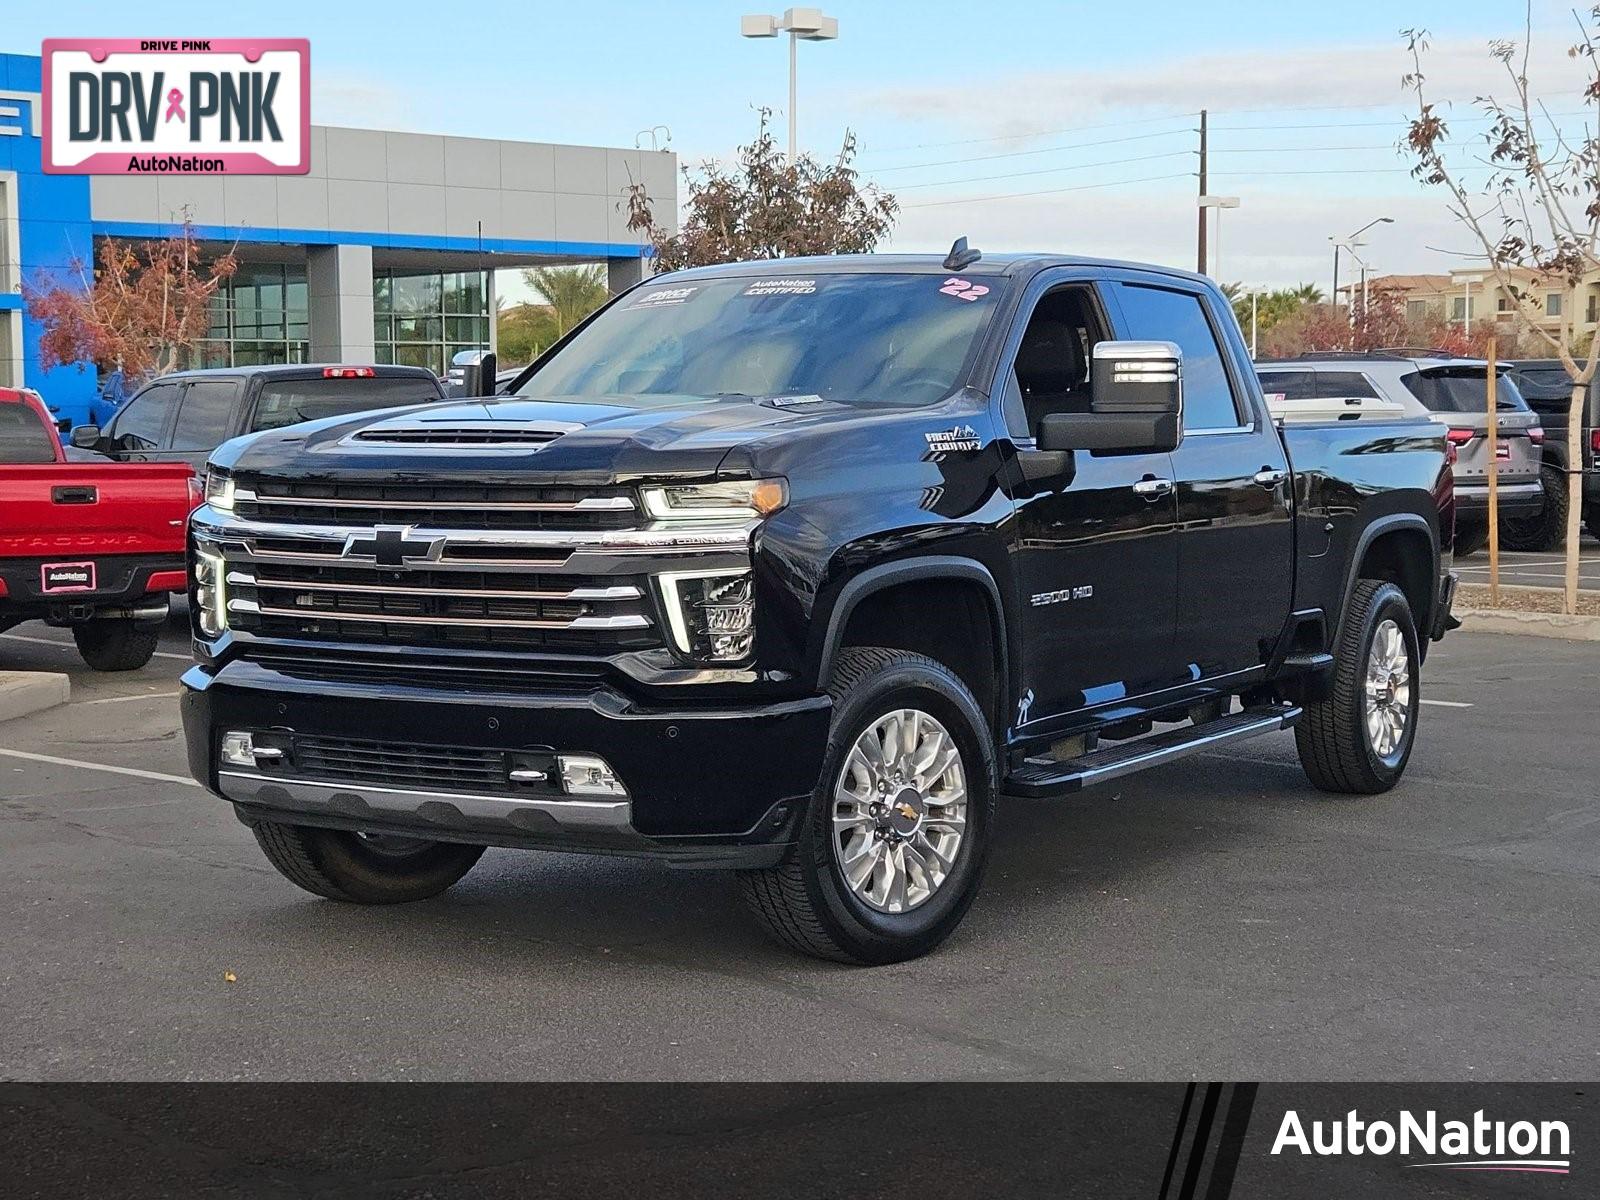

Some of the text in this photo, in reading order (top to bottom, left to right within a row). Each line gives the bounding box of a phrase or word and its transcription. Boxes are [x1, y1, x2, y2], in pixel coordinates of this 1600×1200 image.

[744, 287, 816, 295] CERTIFIED
[925, 432, 955, 442] HIGH
[930, 441, 982, 451] COUNTRY
[3, 536, 142, 547] TACOMA
[1030, 585, 1093, 606] 2500 HD
